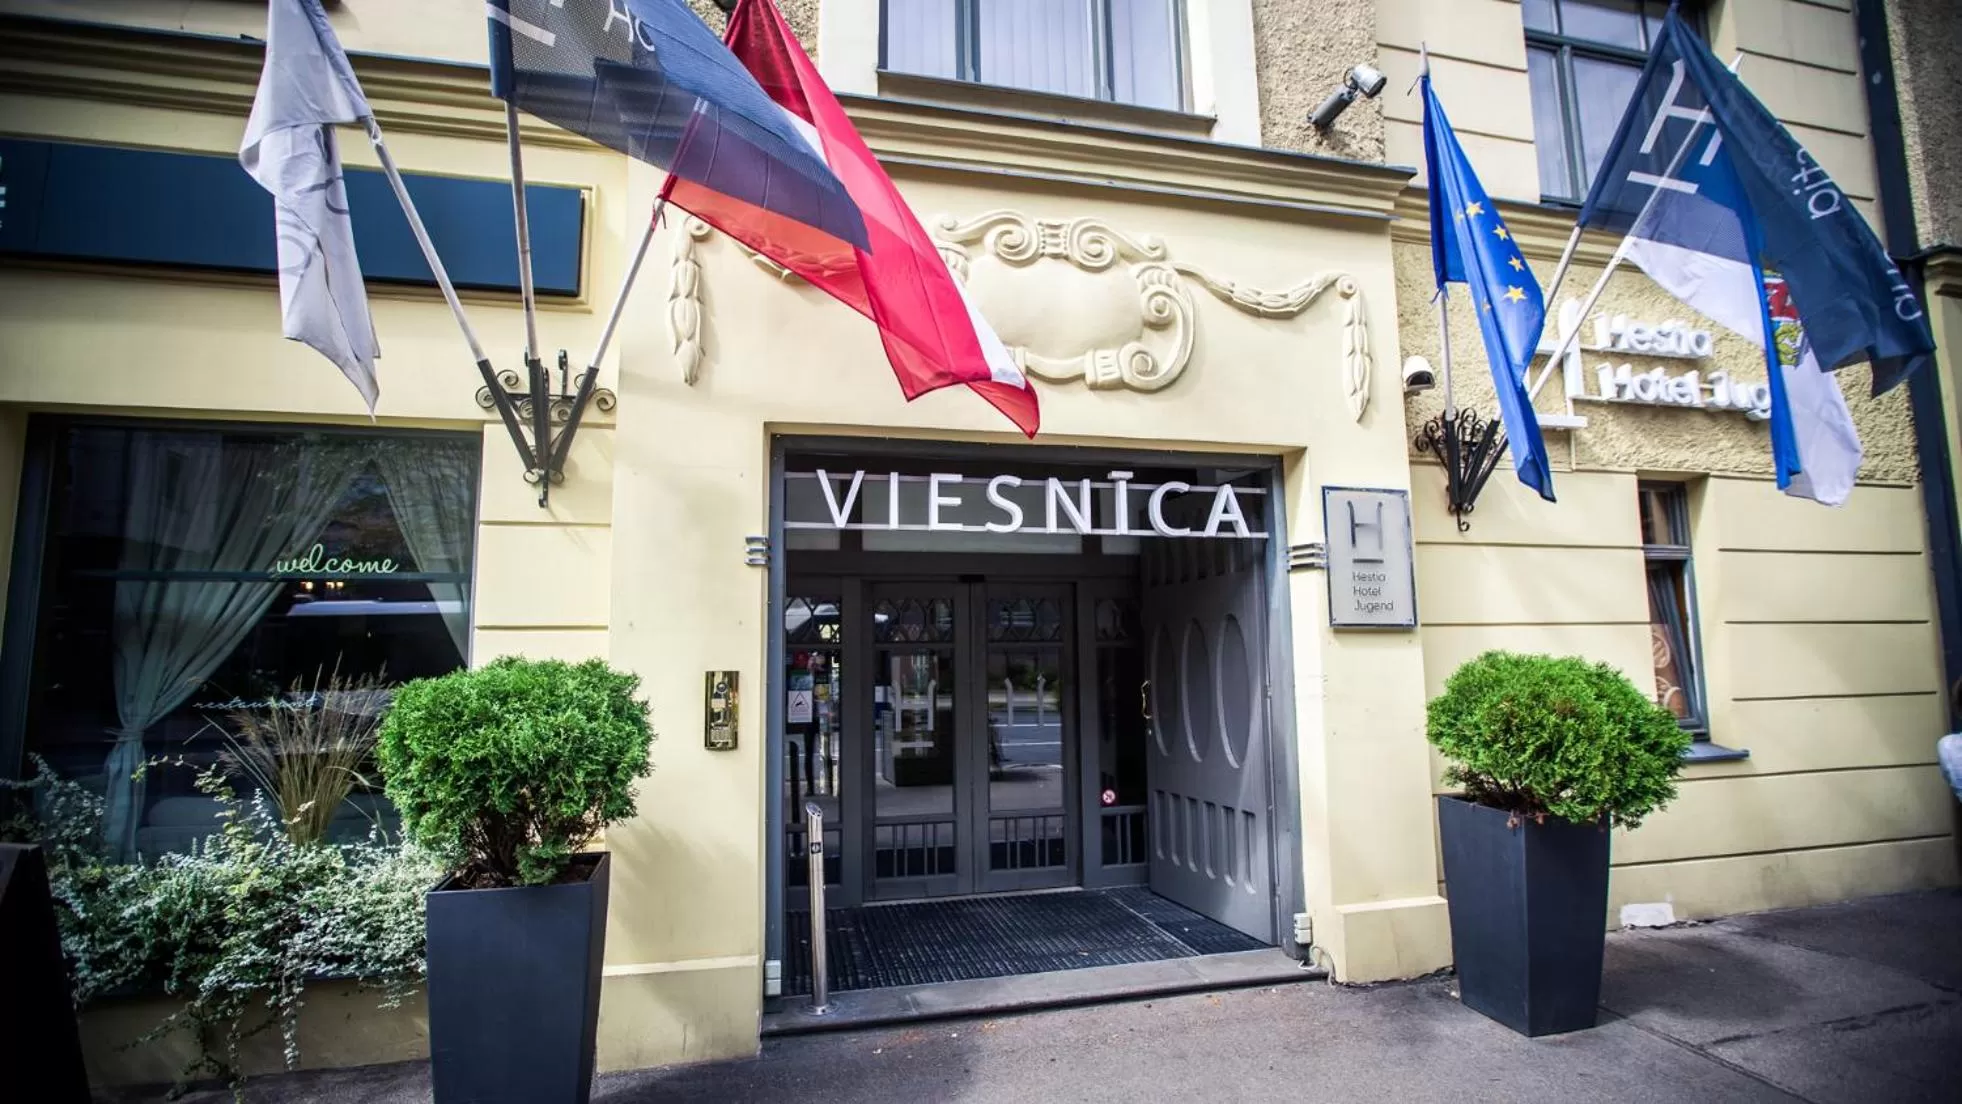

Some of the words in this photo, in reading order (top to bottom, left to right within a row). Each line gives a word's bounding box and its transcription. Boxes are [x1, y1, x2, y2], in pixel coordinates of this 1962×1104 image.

[1590, 311, 1713, 356] Hestia
[1596, 361, 1702, 406] Hotel
[1707, 368, 1772, 421] Jug
[815, 469, 1251, 538] VIESNĪCA
[276, 543, 400, 574] welcome
[1351, 570, 1387, 583] Hestia
[1352, 586, 1382, 597] Hotel
[1353, 599, 1395, 614] Jugend
